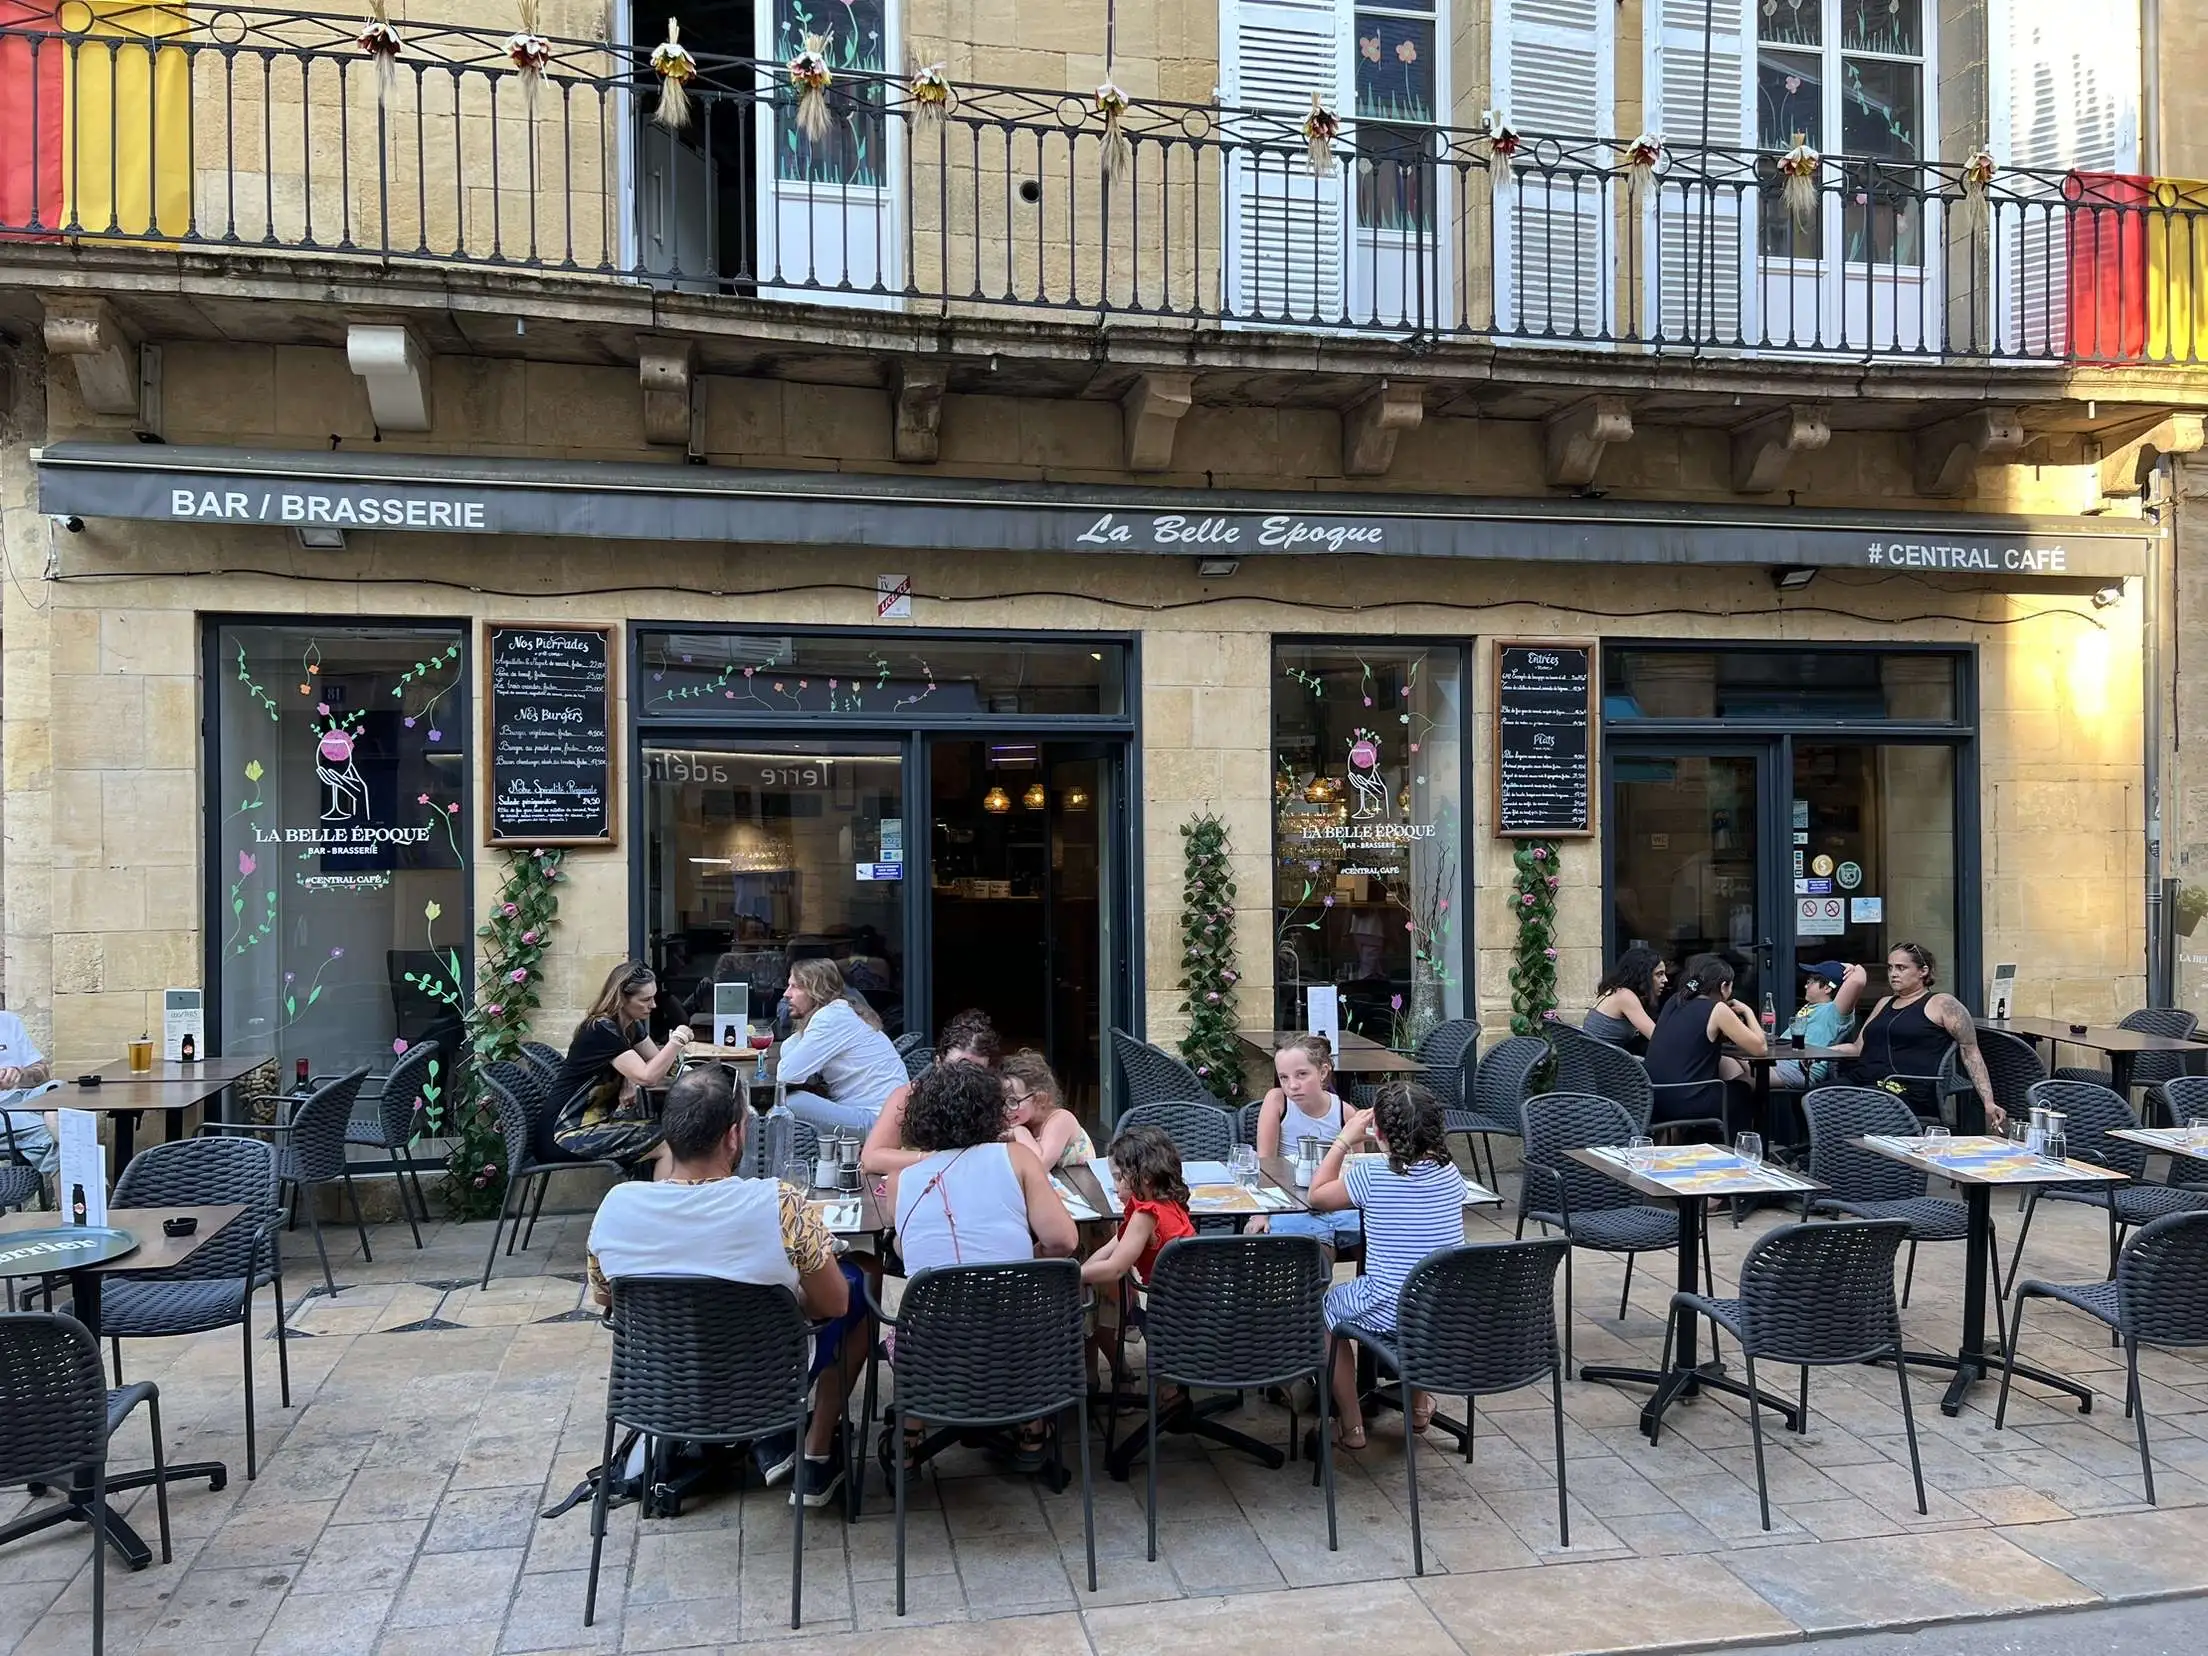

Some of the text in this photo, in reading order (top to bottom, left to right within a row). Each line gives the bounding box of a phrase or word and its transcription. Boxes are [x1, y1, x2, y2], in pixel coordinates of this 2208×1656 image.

[171, 489, 250, 519] BAR
[281, 494, 485, 528] BRASSERIE
[1076, 513, 1383, 552] La Belle Epoque
[1888, 543, 1998, 569] CENTRAL
[2004, 546, 2066, 571] CAFÉ
[508, 635, 589, 653] Nos Pierrades
[1528, 652, 1560, 666] Entrées
[542, 707, 583, 724] Burgers
[1533, 733, 1555, 746] Plats
[255, 825, 430, 846] LA BELLE ÉPOQUE
[1302, 822, 1436, 840] LA BELLE ÉPOQUE
[308, 847, 326, 855] BAR
[332, 846, 378, 855] BRASSERIE
[356, 874, 382, 884] CAFÉ
